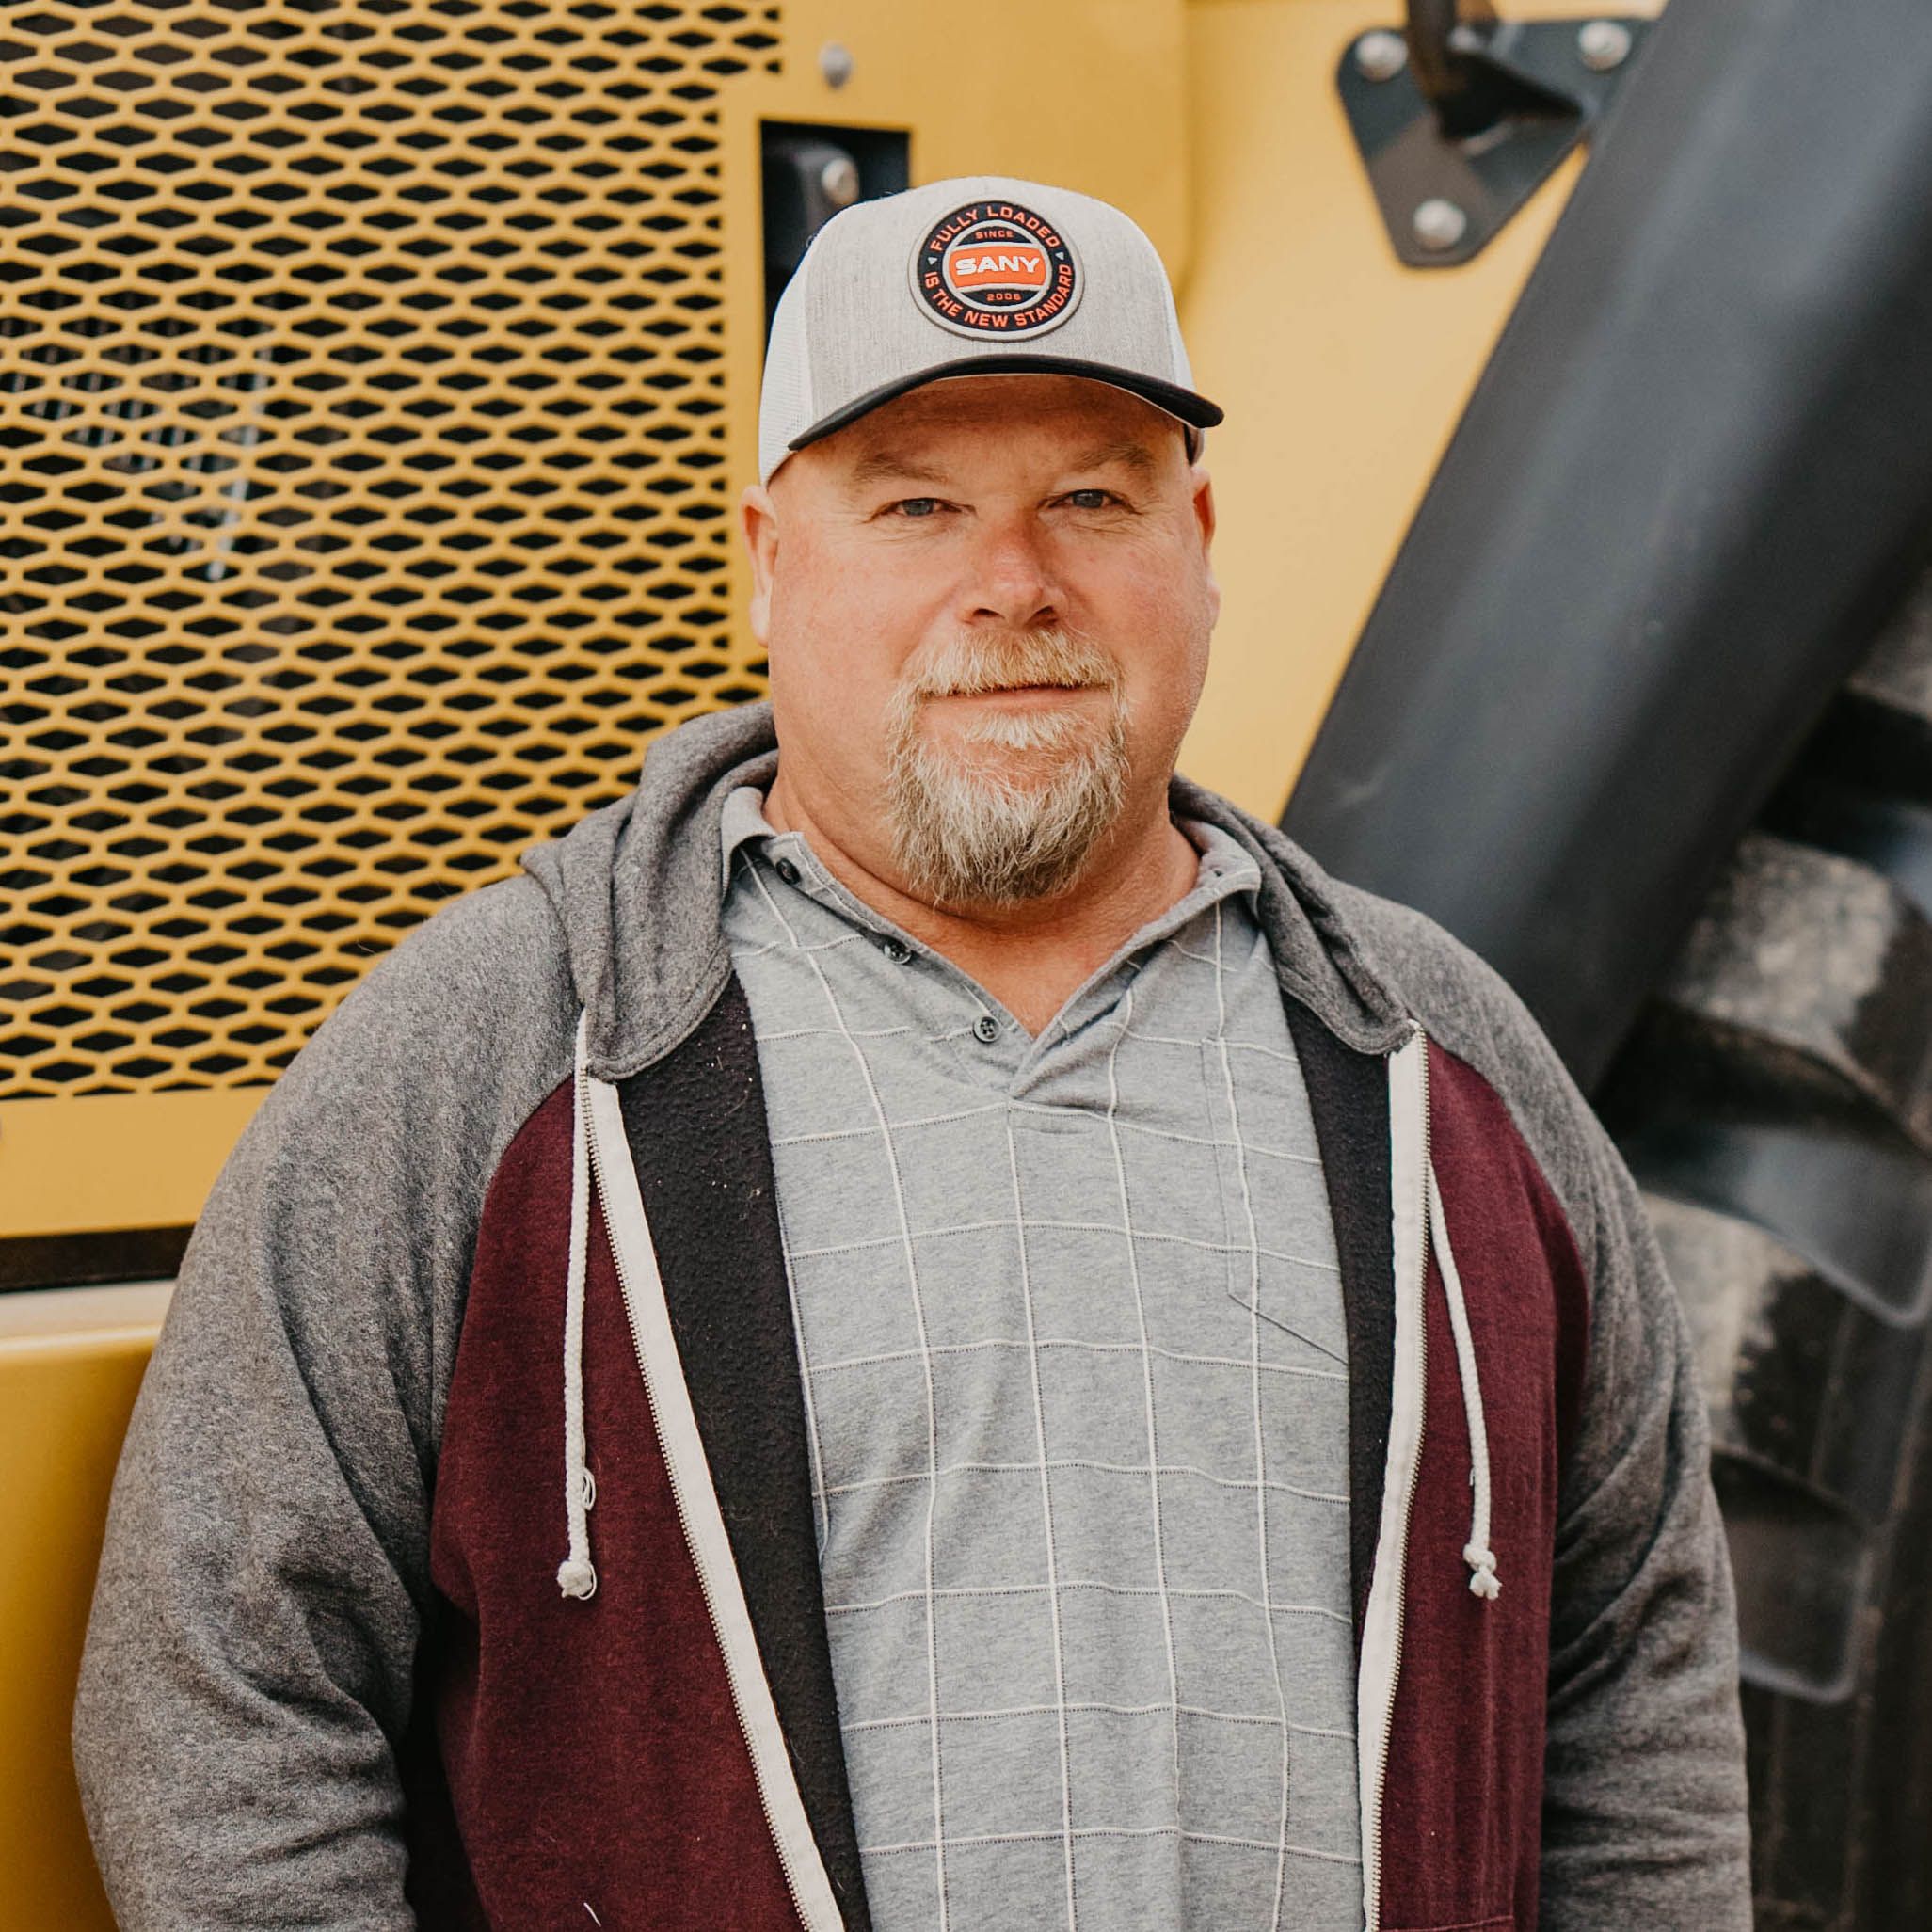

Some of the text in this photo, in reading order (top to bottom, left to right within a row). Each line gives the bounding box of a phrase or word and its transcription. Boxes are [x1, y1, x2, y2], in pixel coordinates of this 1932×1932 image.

[930, 205, 1061, 251] FULLY LOADED
[975, 230, 1014, 239] SINCE
[955, 255, 1040, 276] SANY
[924, 263, 1072, 327] IS THE NEW STANDARD
